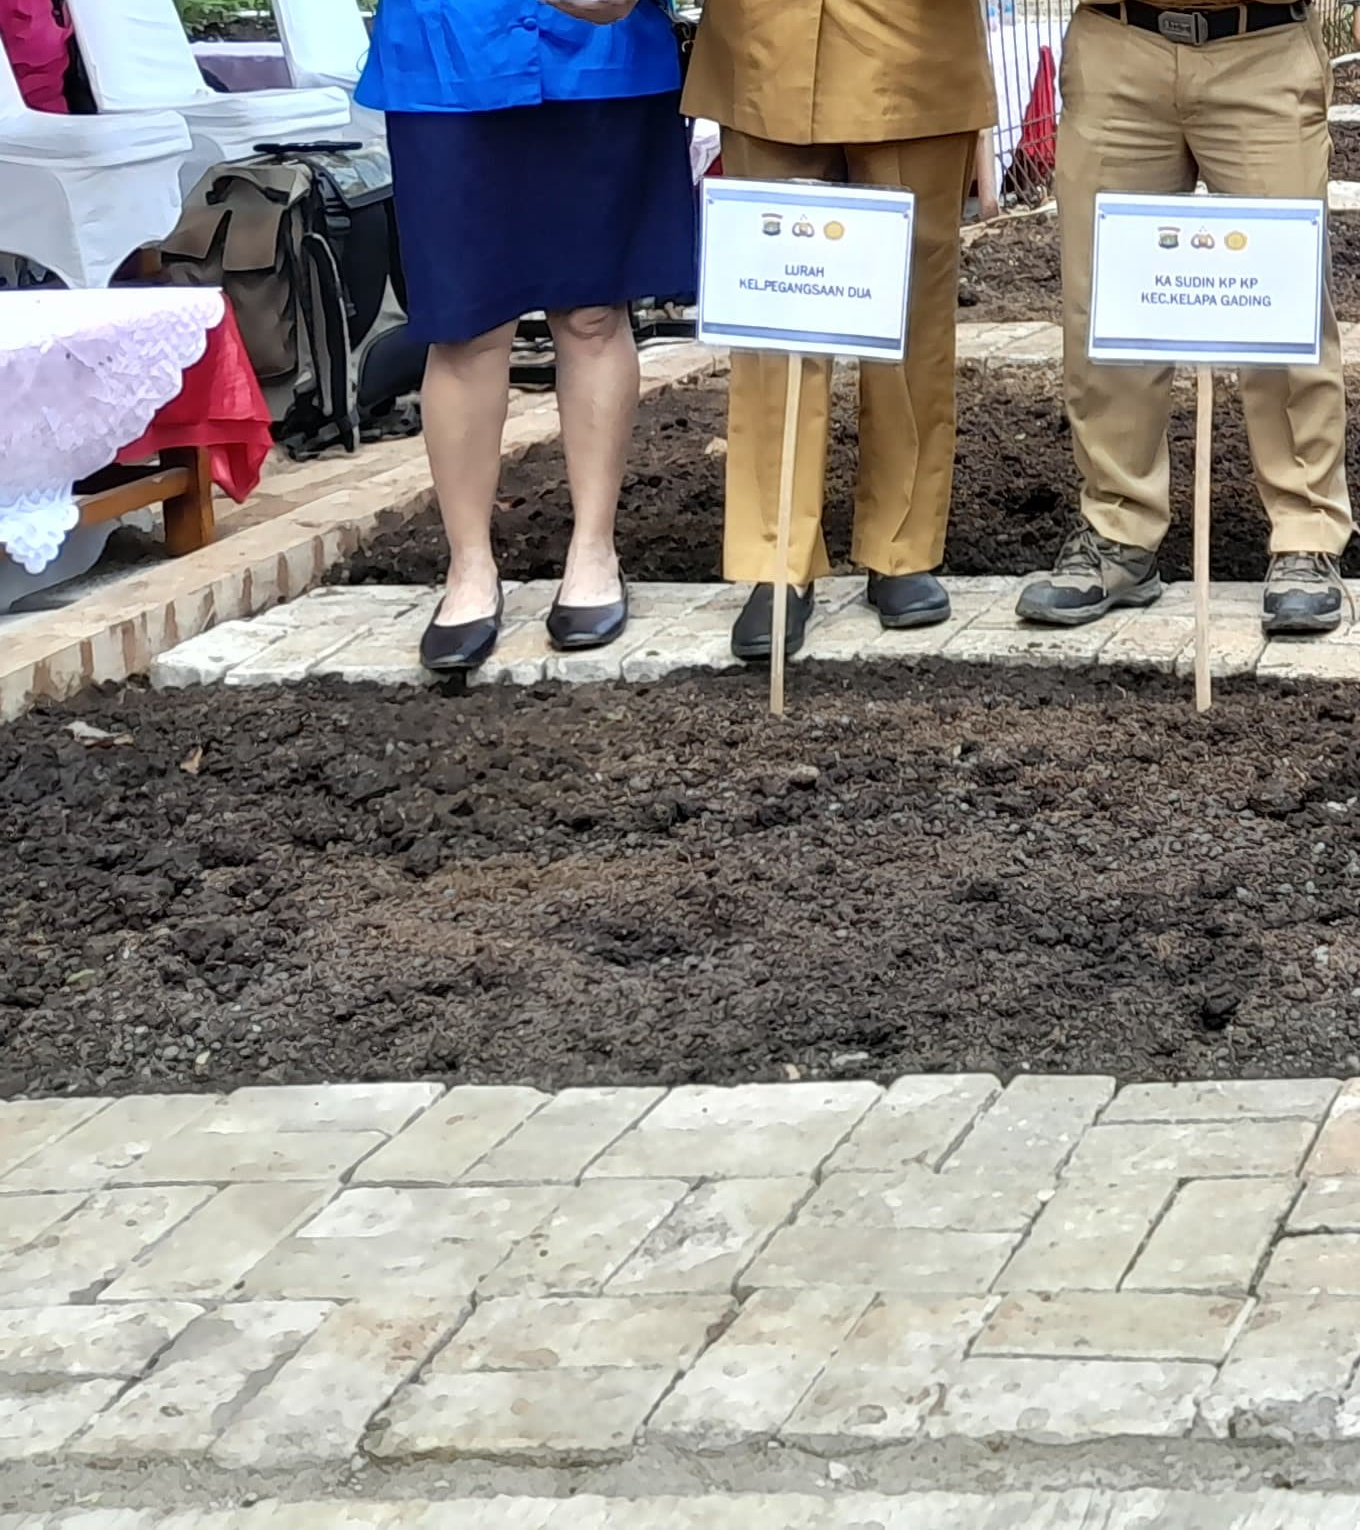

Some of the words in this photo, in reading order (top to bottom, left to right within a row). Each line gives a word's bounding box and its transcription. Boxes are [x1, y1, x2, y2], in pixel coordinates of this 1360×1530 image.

[784, 264, 825, 278] LURAH
[1155, 275, 1172, 287] KA
[1175, 276, 1215, 288] SUDIN
[1219, 277, 1237, 288] KP
[1240, 277, 1258, 289] KP
[847, 286, 872, 299] DUA
[1141, 292, 1217, 306] KEC.KELAPA
[1220, 294, 1271, 307] GADING
